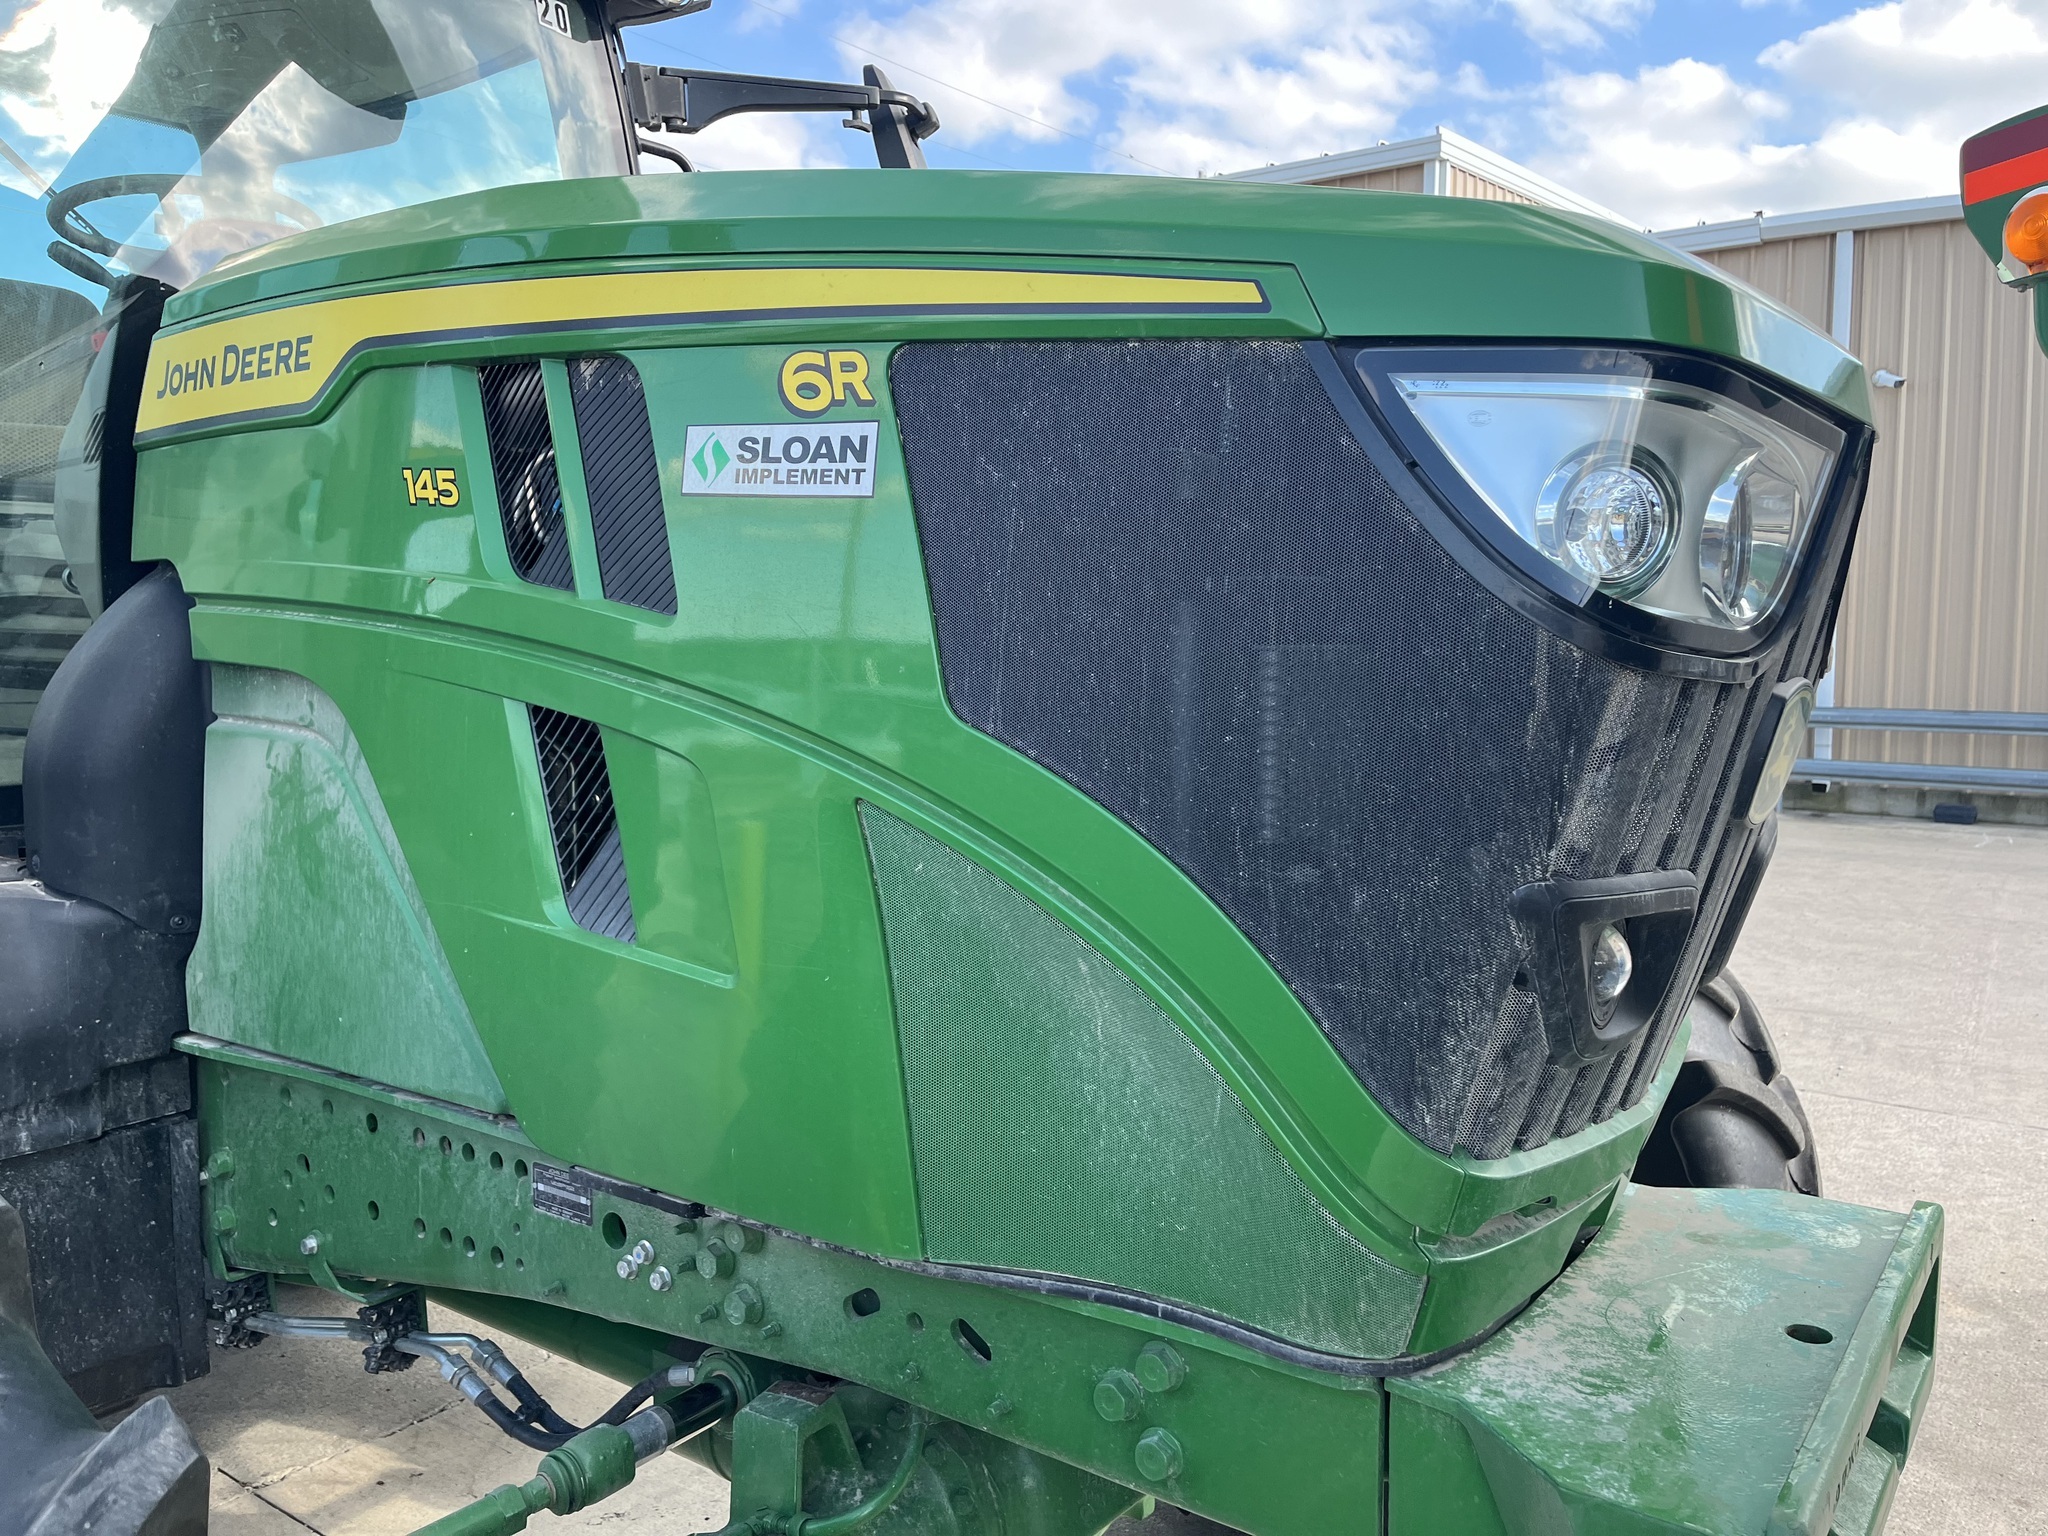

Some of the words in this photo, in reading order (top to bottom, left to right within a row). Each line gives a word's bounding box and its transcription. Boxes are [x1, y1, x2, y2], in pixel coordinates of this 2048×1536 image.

[538, 0, 568, 34] 20
[156, 355, 217, 400] JOHN
[220, 334, 314, 386] DEERE
[777, 348, 877, 420] 6R
[735, 434, 869, 465] SLOAN
[401, 466, 460, 508] 145
[734, 468, 867, 485] IMPLEMENT
